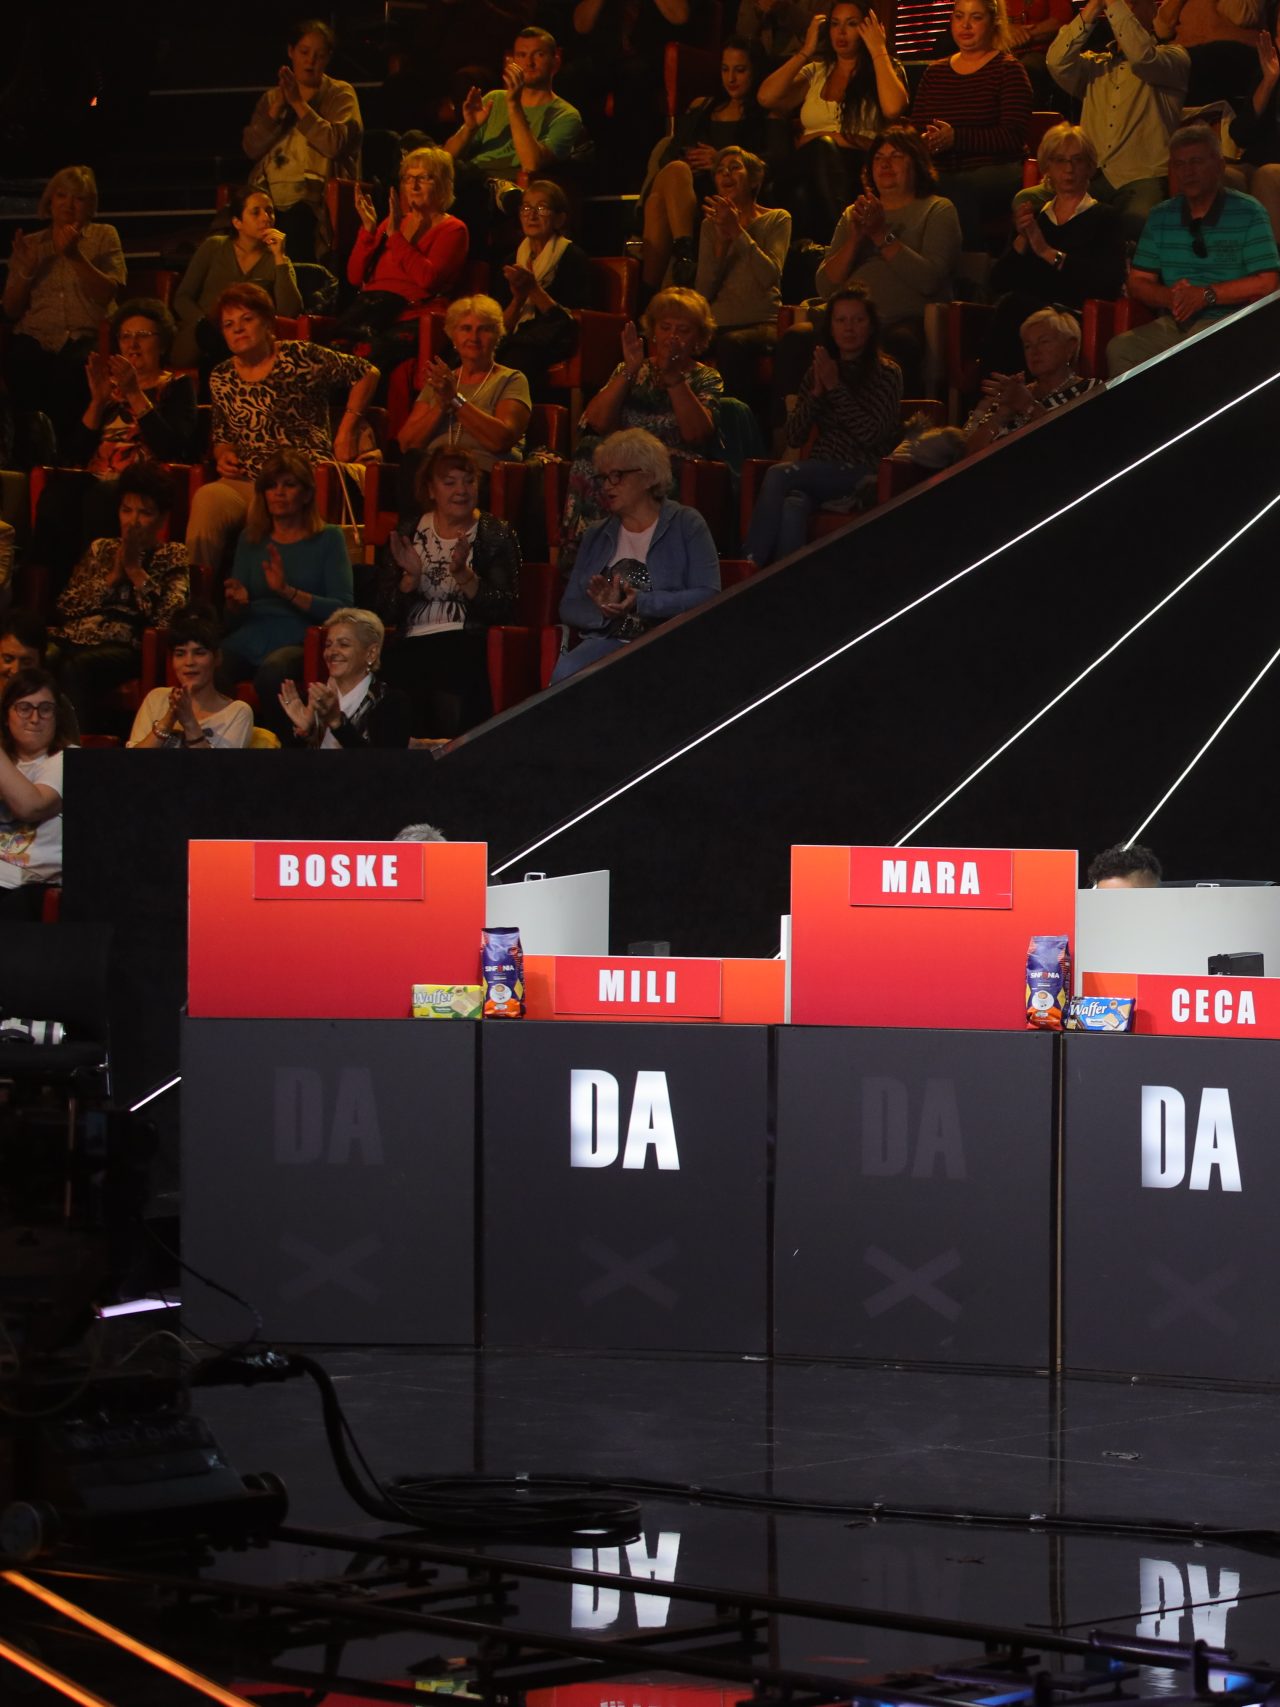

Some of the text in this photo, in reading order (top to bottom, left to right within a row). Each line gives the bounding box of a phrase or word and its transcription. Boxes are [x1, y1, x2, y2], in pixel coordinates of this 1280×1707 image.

[279, 853, 399, 888] BOSKE
[881, 859, 981, 895] MARA
[598, 969, 677, 1004] MILI
[1069, 1001, 1108, 1017] Waffer
[1171, 987, 1257, 1026] CECA
[273, 1066, 383, 1166] DA
[570, 1069, 681, 1171] DA
[860, 1076, 968, 1180] DA
[1140, 1085, 1244, 1193] DA
